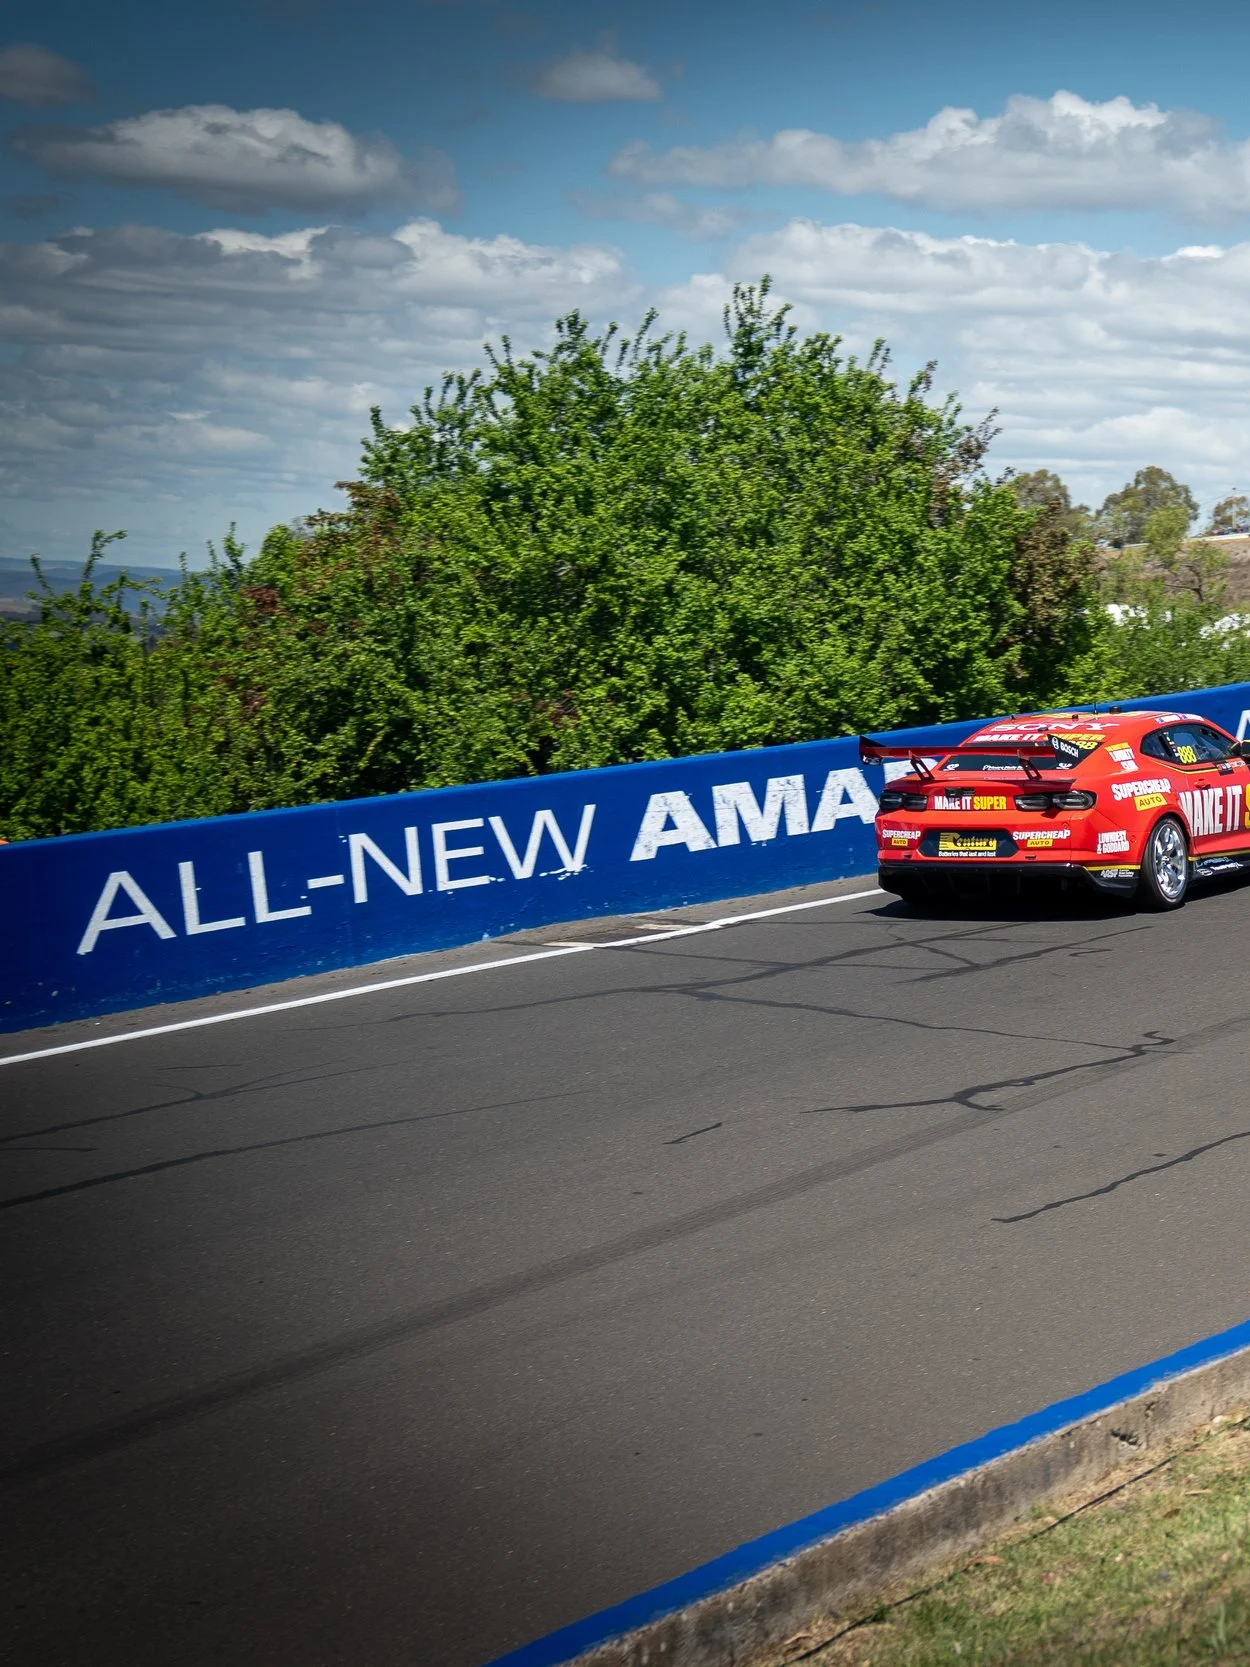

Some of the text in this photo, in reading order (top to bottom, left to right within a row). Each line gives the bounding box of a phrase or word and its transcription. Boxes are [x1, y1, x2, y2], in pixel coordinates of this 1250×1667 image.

[990, 723, 1120, 731] SONY
[1021, 733, 1045, 741] IT
[1060, 742, 1079, 758] BOSCH
[1177, 746, 1197, 764] 888
[1111, 778, 1171, 801] SUPERCHEAP
[934, 796, 1007, 810] MAKE IT SUPER
[1139, 796, 1162, 807] AUTO
[1226, 785, 1243, 831] IT
[882, 829, 921, 839] SUPERCHEAP
[1013, 829, 1071, 840] SUPERCHEAP
[77, 758, 938, 956] ALL-NEW AMA
